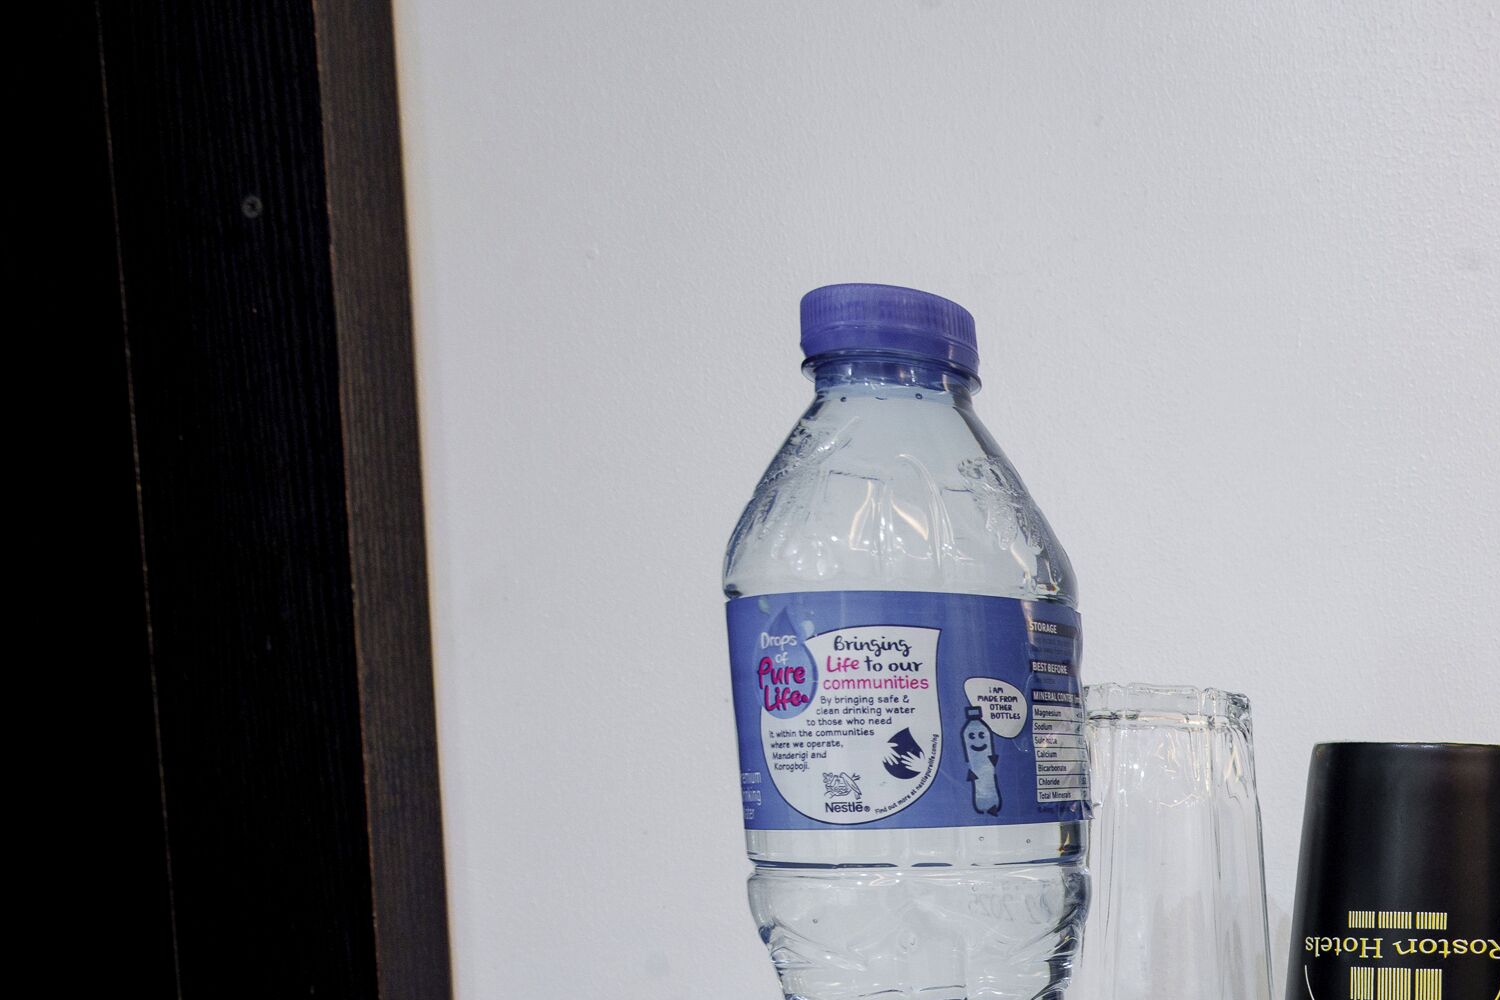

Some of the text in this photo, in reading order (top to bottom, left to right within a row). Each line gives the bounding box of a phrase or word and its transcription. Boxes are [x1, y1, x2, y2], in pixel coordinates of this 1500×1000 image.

[1029, 621, 1057, 634] STORAGE
[760, 632, 797, 650] Drops
[833, 635, 912, 657] Bringing
[775, 651, 789, 664] of
[826, 655, 923, 673] Life to our
[1032, 661, 1068, 674] BEST BEFORE
[758, 656, 806, 689] Pure
[823, 674, 929, 690] communities
[820, 695, 910, 706] By bringing safe &
[1000, 695, 1018, 703] FROM
[1033, 690, 1057, 701] MINERAL
[816, 706, 916, 716] clean drinking water
[989, 704, 1013, 712] OTHER
[1034, 707, 1061, 718] Magnesium
[807, 717, 892, 726] to those who need
[990, 712, 1021, 720] BOTTLES
[1034, 722, 1053, 731] Sodium
[775, 730, 797, 738] within
[798, 729, 813, 737] the
[815, 728, 875, 737] communities
[770, 741, 790, 749] where
[772, 750, 827, 761] Manderigi and
[1037, 750, 1057, 758] Calcium
[1038, 764, 1067, 772] Bicarbonate
[1039, 777, 1060, 786] Chloride
[1039, 791, 1051, 800] Total
[1052, 791, 1072, 799] Minerals
[1305, 936, 1383, 958] Hotels
